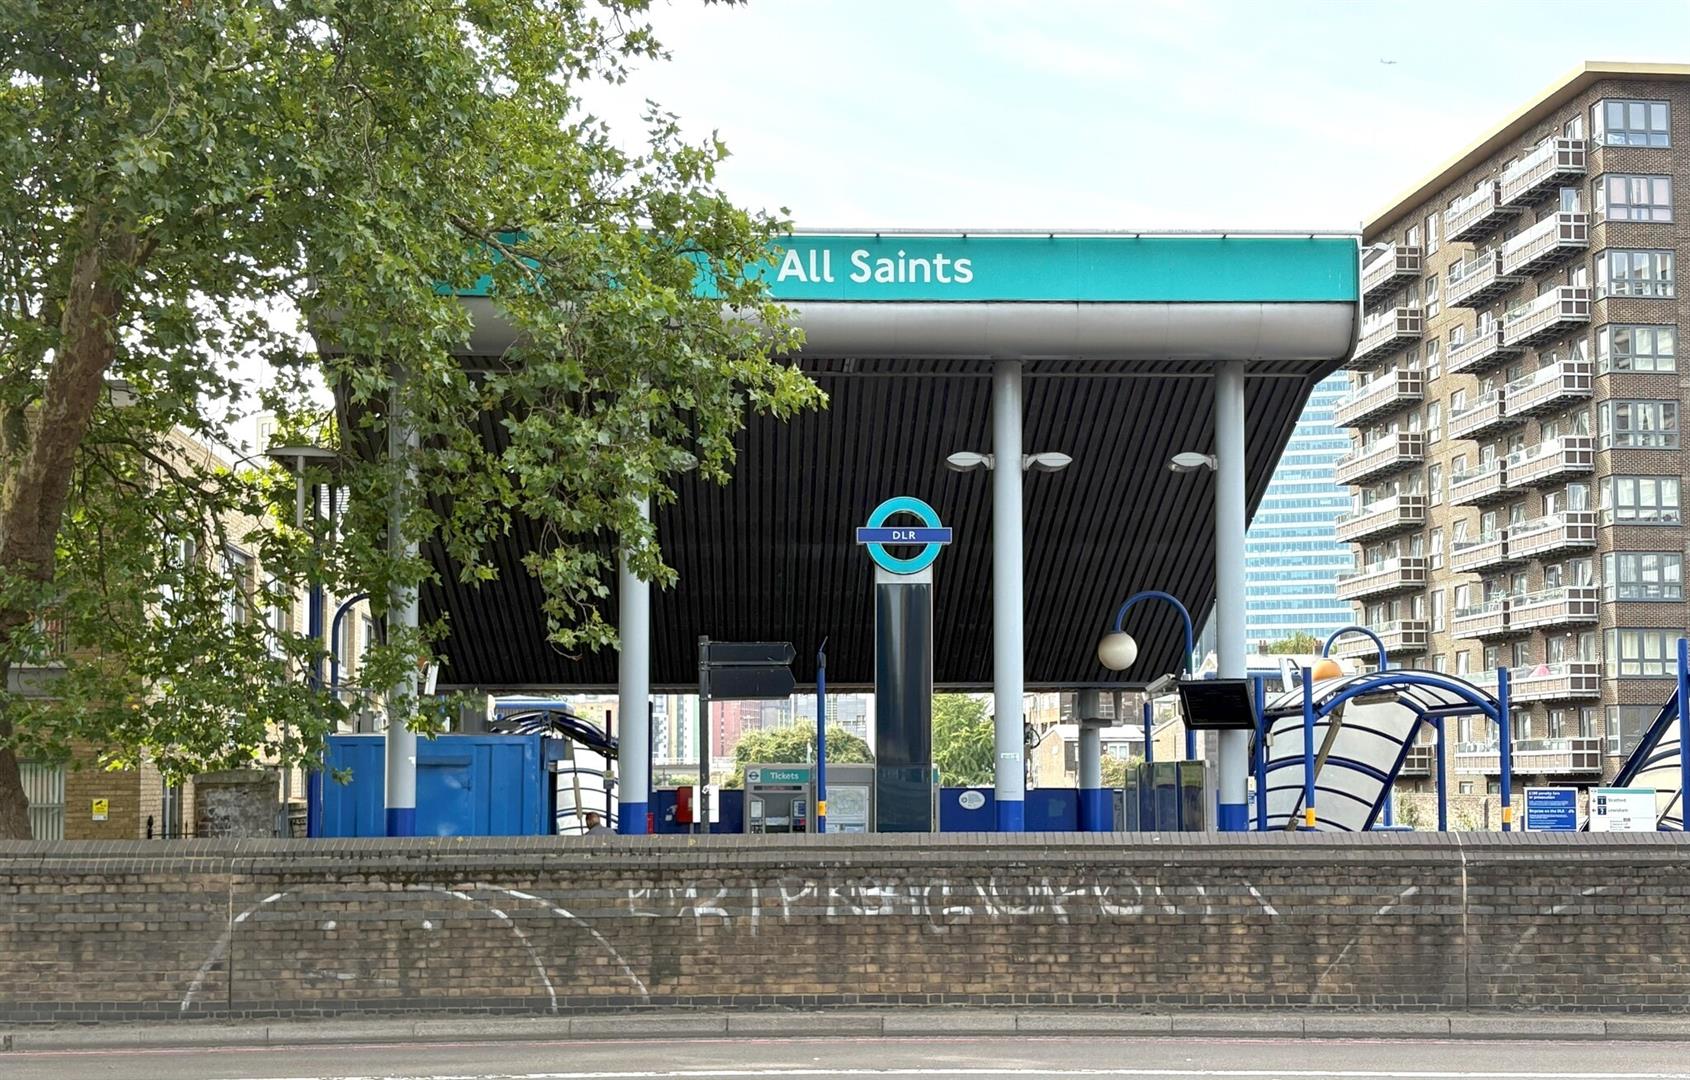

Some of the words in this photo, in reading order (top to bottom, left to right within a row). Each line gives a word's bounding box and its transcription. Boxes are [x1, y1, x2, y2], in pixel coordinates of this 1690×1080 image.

[776, 249, 835, 283] All
[850, 249, 974, 283] Saints
[892, 530, 916, 540] DLR
[770, 772, 799, 780] Tickets
